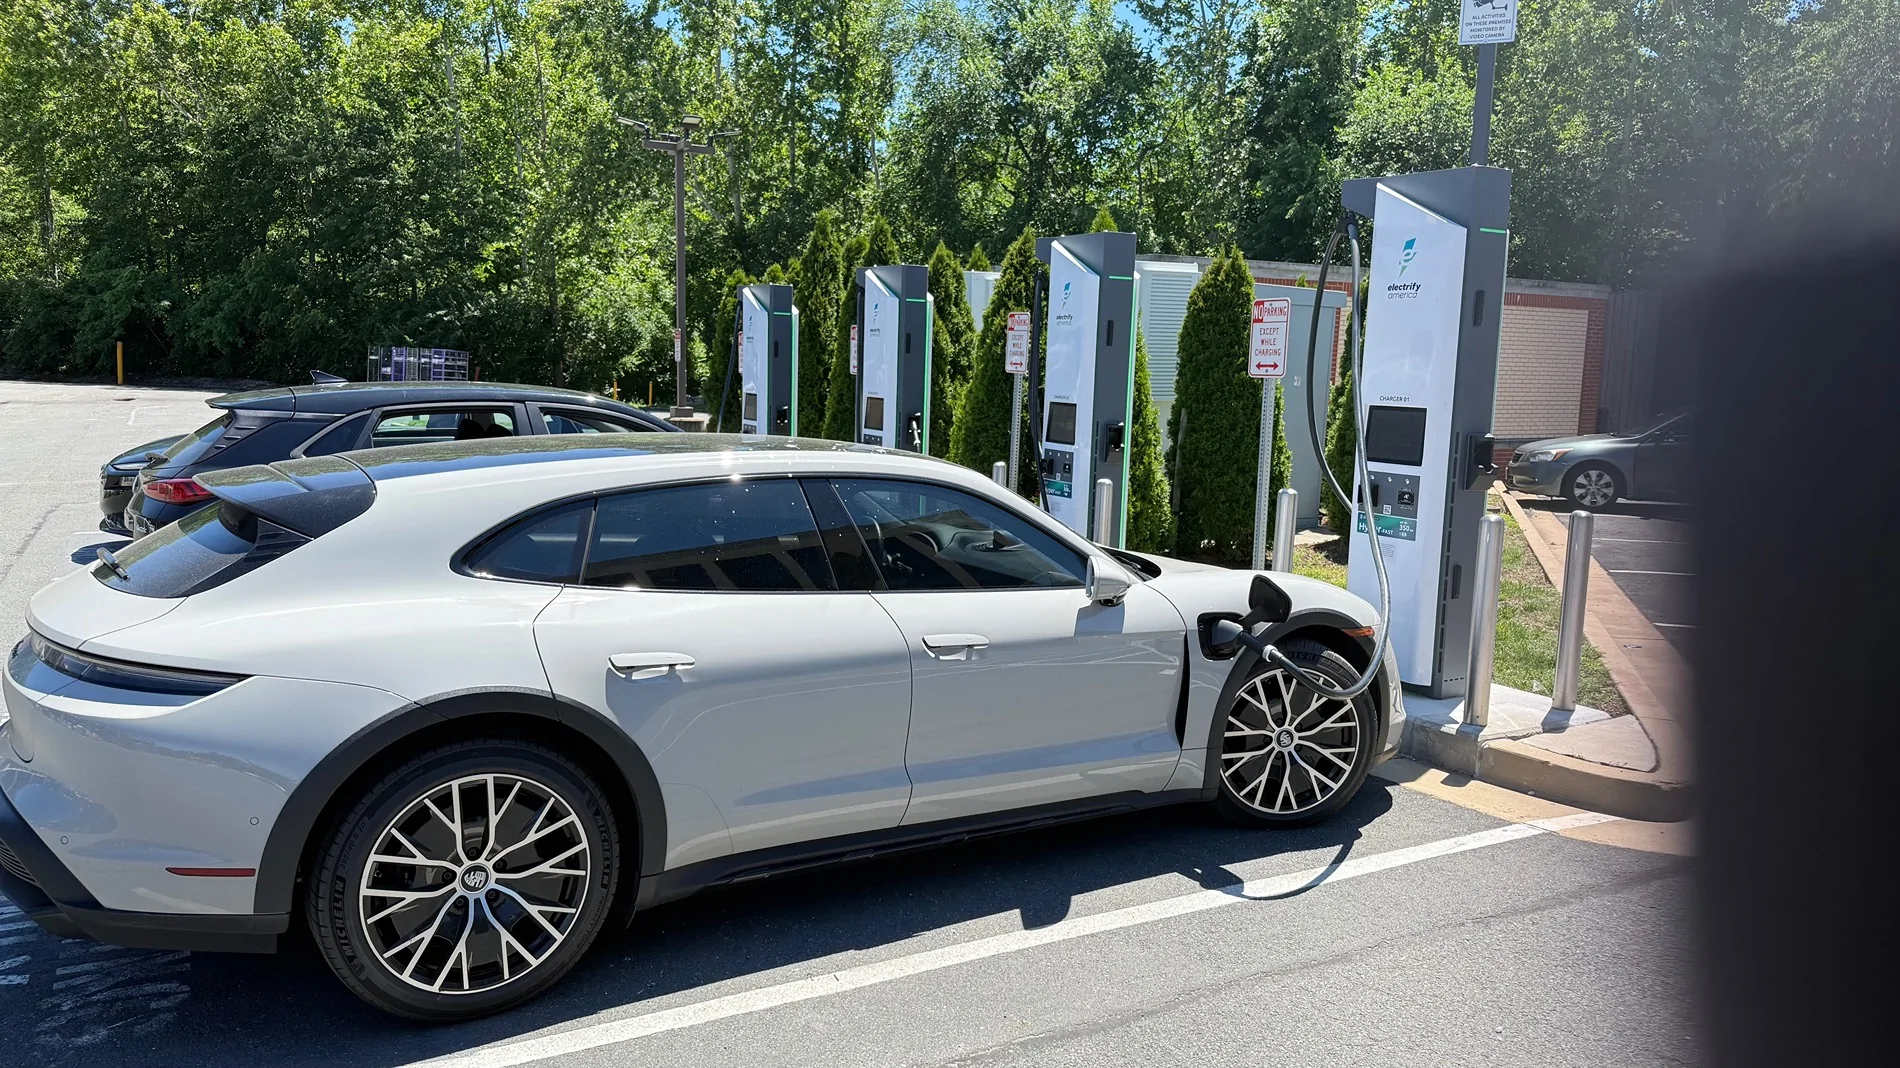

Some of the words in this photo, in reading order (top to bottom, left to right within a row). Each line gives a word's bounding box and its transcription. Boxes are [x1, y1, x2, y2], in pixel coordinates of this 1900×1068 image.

[1387, 282, 1421, 292] electrify
[1387, 292, 1418, 300] america
[1253, 305, 1264, 319] NO
[1264, 306, 1287, 317] PARKING
[1259, 327, 1279, 336] EXCEPT
[1260, 338, 1277, 346] WHILE
[1254, 348, 1282, 357] CHARGING
[1399, 524, 1409, 532] 350
[333, 878, 355, 957] MICHELIN
